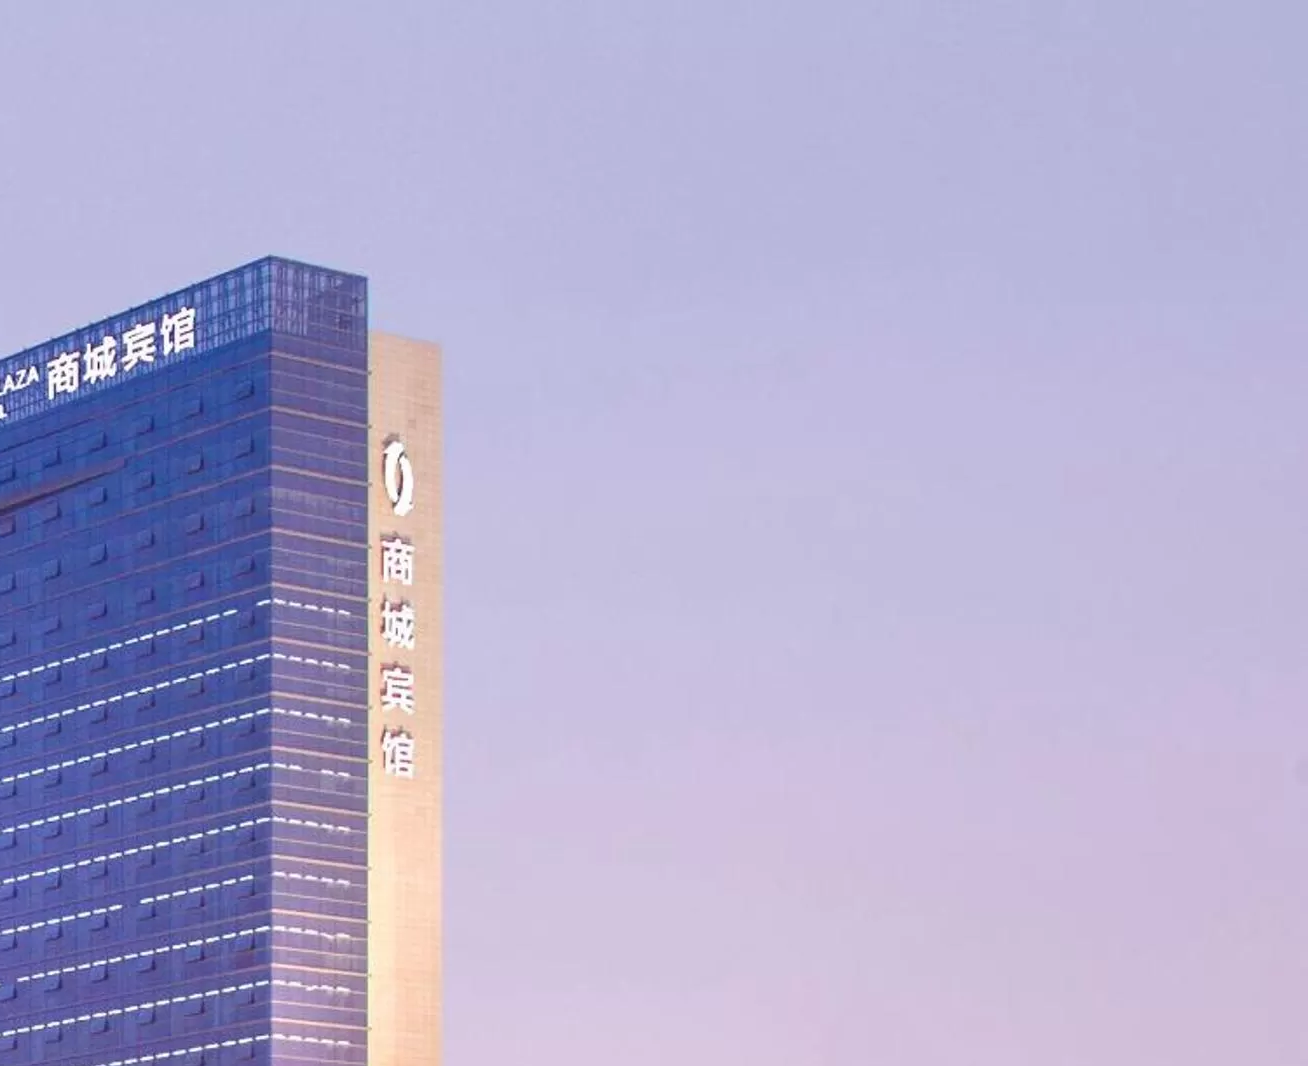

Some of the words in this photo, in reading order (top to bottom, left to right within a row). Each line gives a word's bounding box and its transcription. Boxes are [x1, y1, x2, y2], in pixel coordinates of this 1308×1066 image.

[47, 307, 196, 399] 商城宾馆
[382, 538, 416, 779] 商城宾馆
